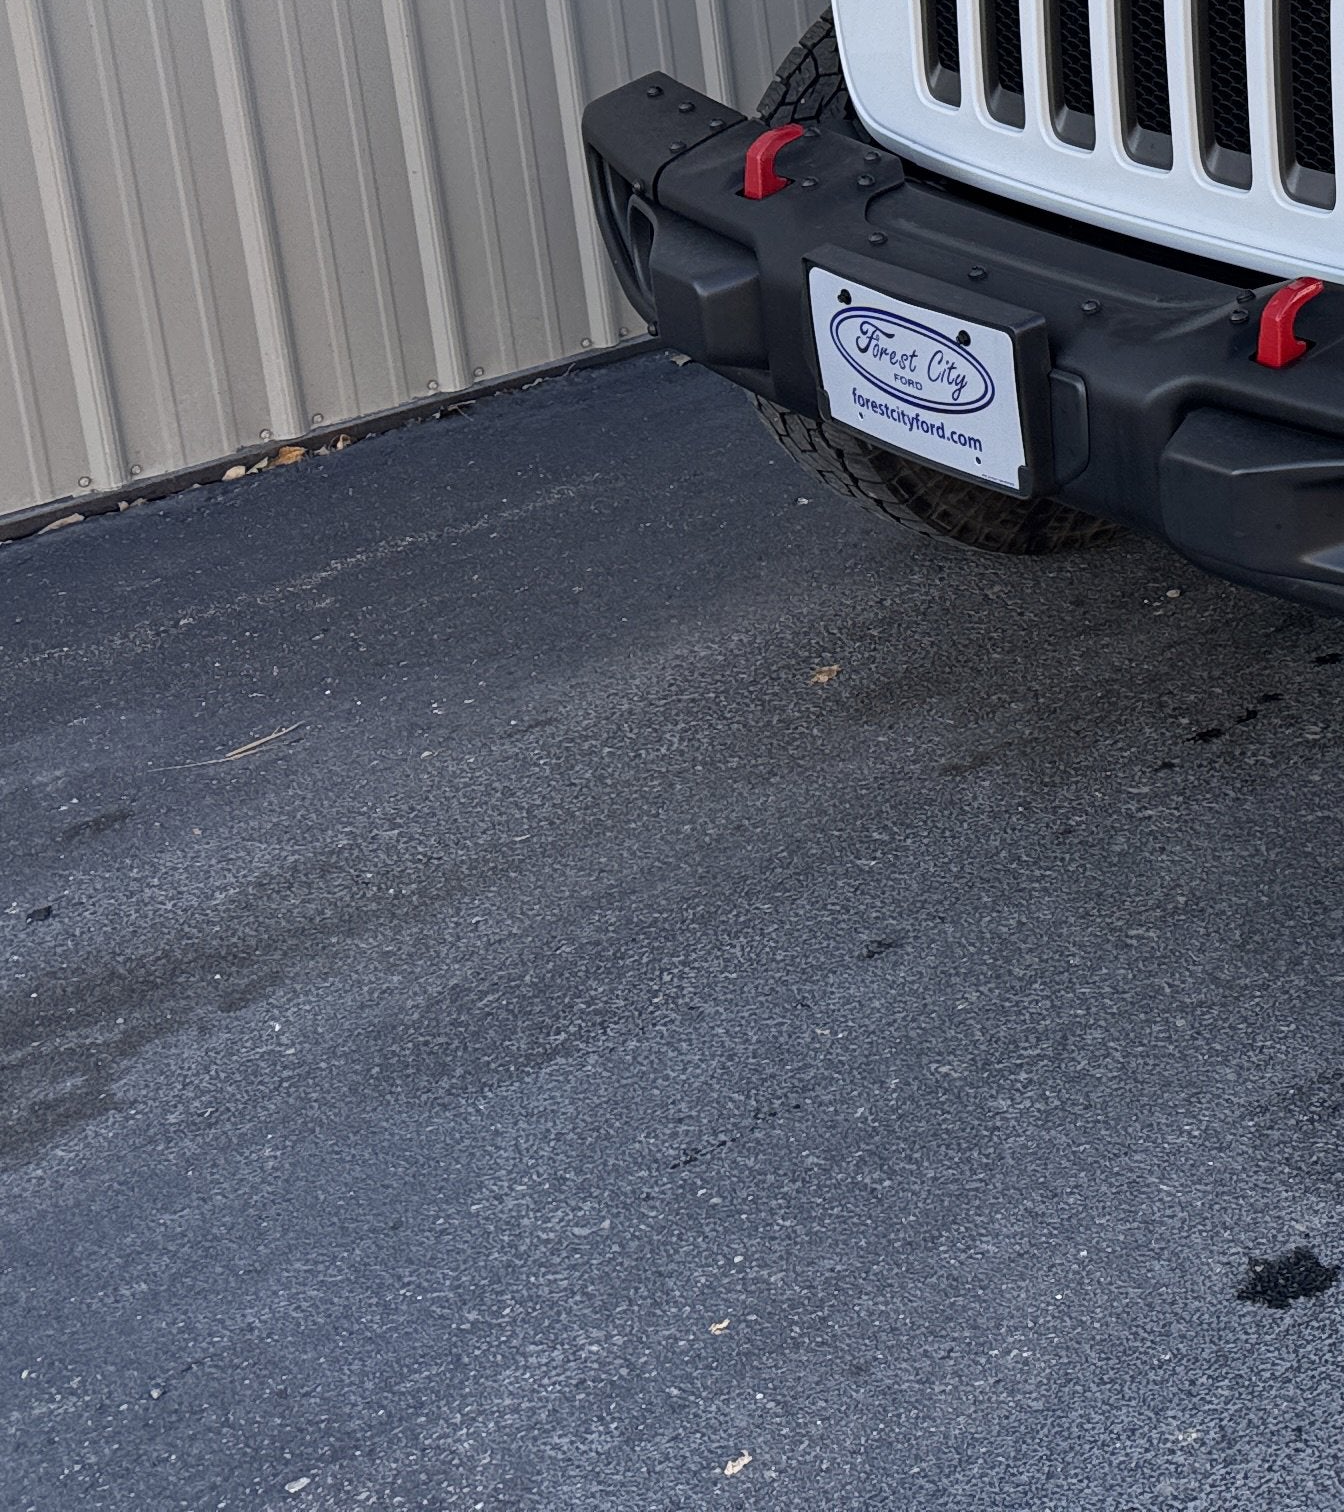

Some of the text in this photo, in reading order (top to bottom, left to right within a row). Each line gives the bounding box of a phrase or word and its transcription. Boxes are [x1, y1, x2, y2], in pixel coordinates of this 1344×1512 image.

[855, 320, 969, 402] Forest City
[893, 373, 923, 391] FORD
[852, 388, 983, 452] forestcityford.com
